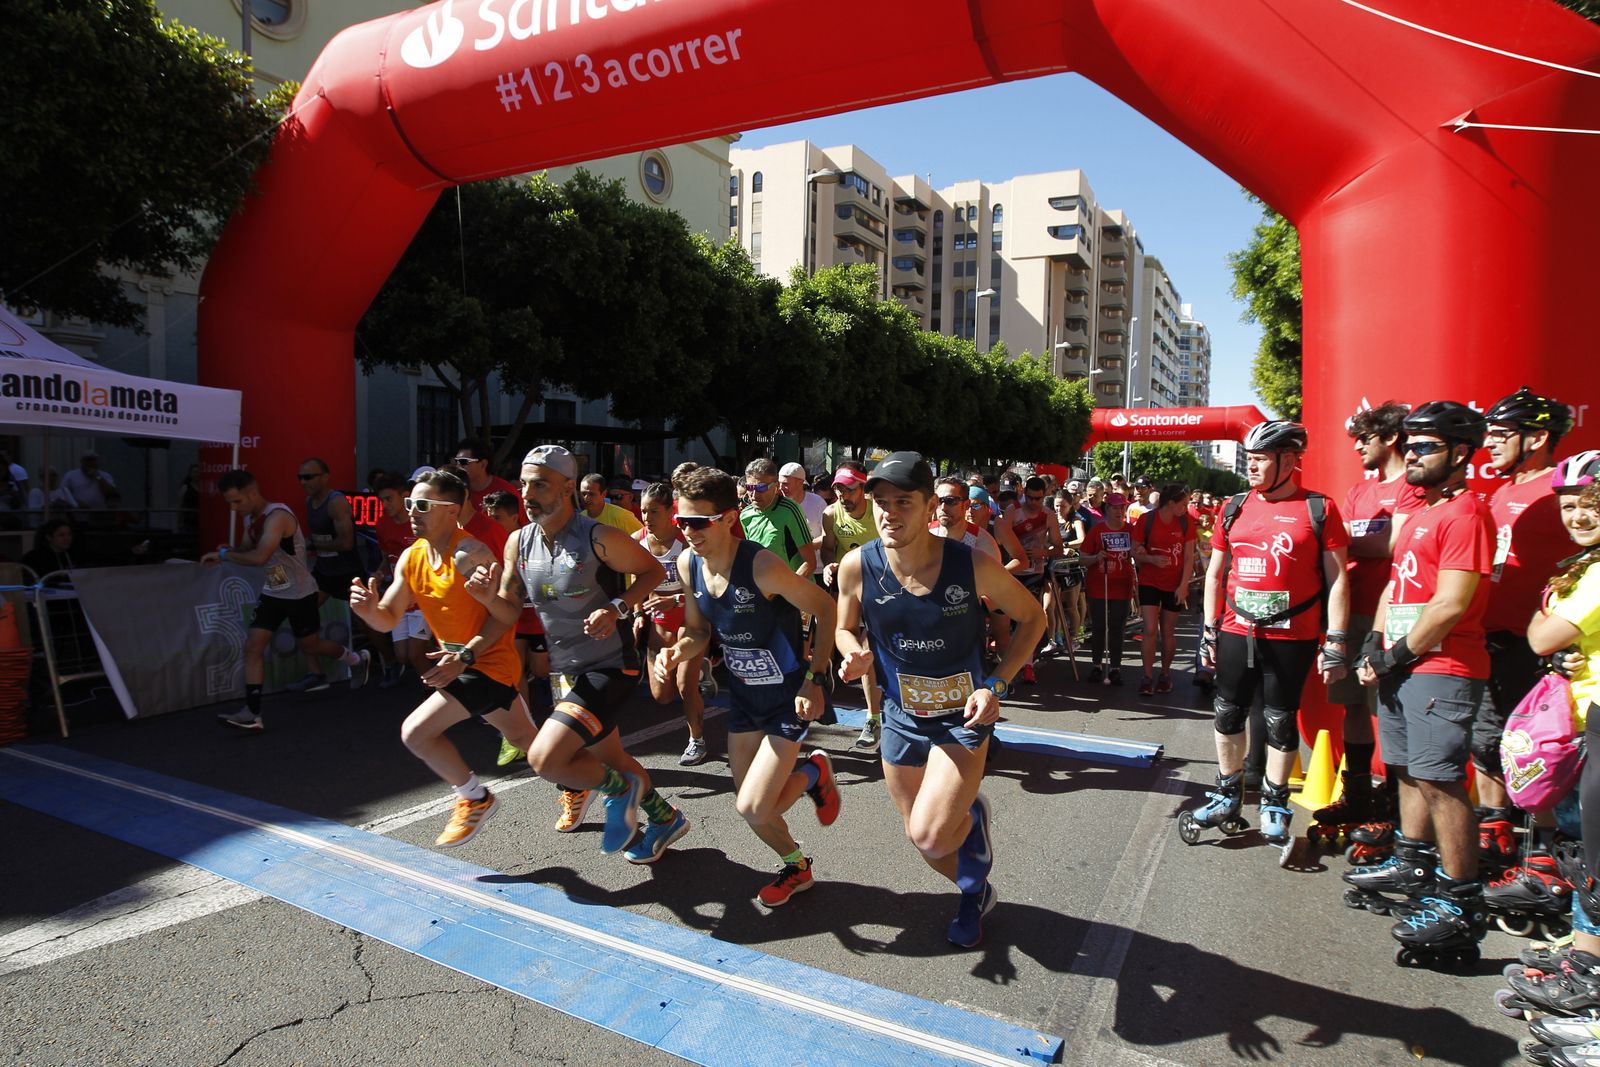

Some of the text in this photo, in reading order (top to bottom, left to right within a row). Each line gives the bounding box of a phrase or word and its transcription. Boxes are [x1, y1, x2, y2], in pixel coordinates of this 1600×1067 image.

[0, 373, 178, 413] andolameta
[16, 401, 178, 425] cronometraje deportivo
[1129, 413, 1204, 426] Santander
[898, 638, 945, 650] DEHARO
[729, 656, 768, 672] 2245
[907, 687, 962, 704] 3230
